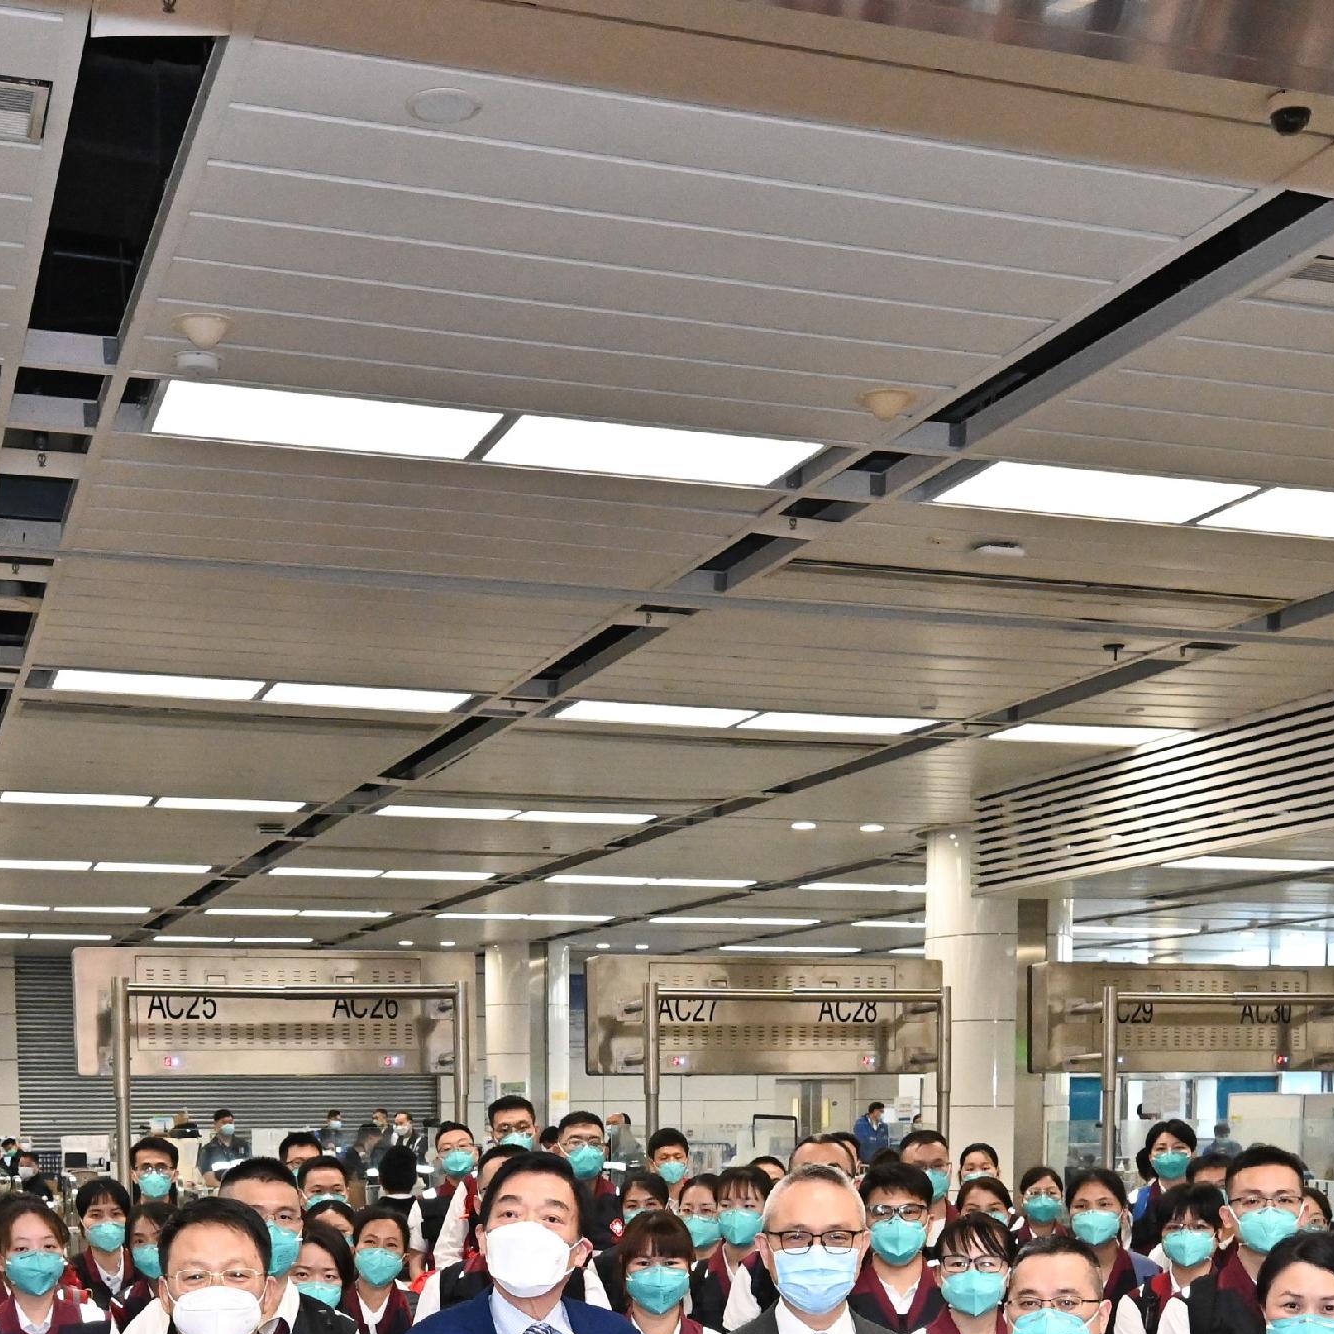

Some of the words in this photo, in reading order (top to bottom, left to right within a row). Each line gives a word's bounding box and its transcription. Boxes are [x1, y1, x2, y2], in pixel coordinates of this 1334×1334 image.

[147, 995, 217, 1020] AC25
[332, 998, 399, 1020] AC26
[658, 1000, 717, 1022] AC27
[818, 1001, 878, 1023] AC28
[1100, 1002, 1154, 1024] C29
[1240, 1003, 1291, 1024] AC30
